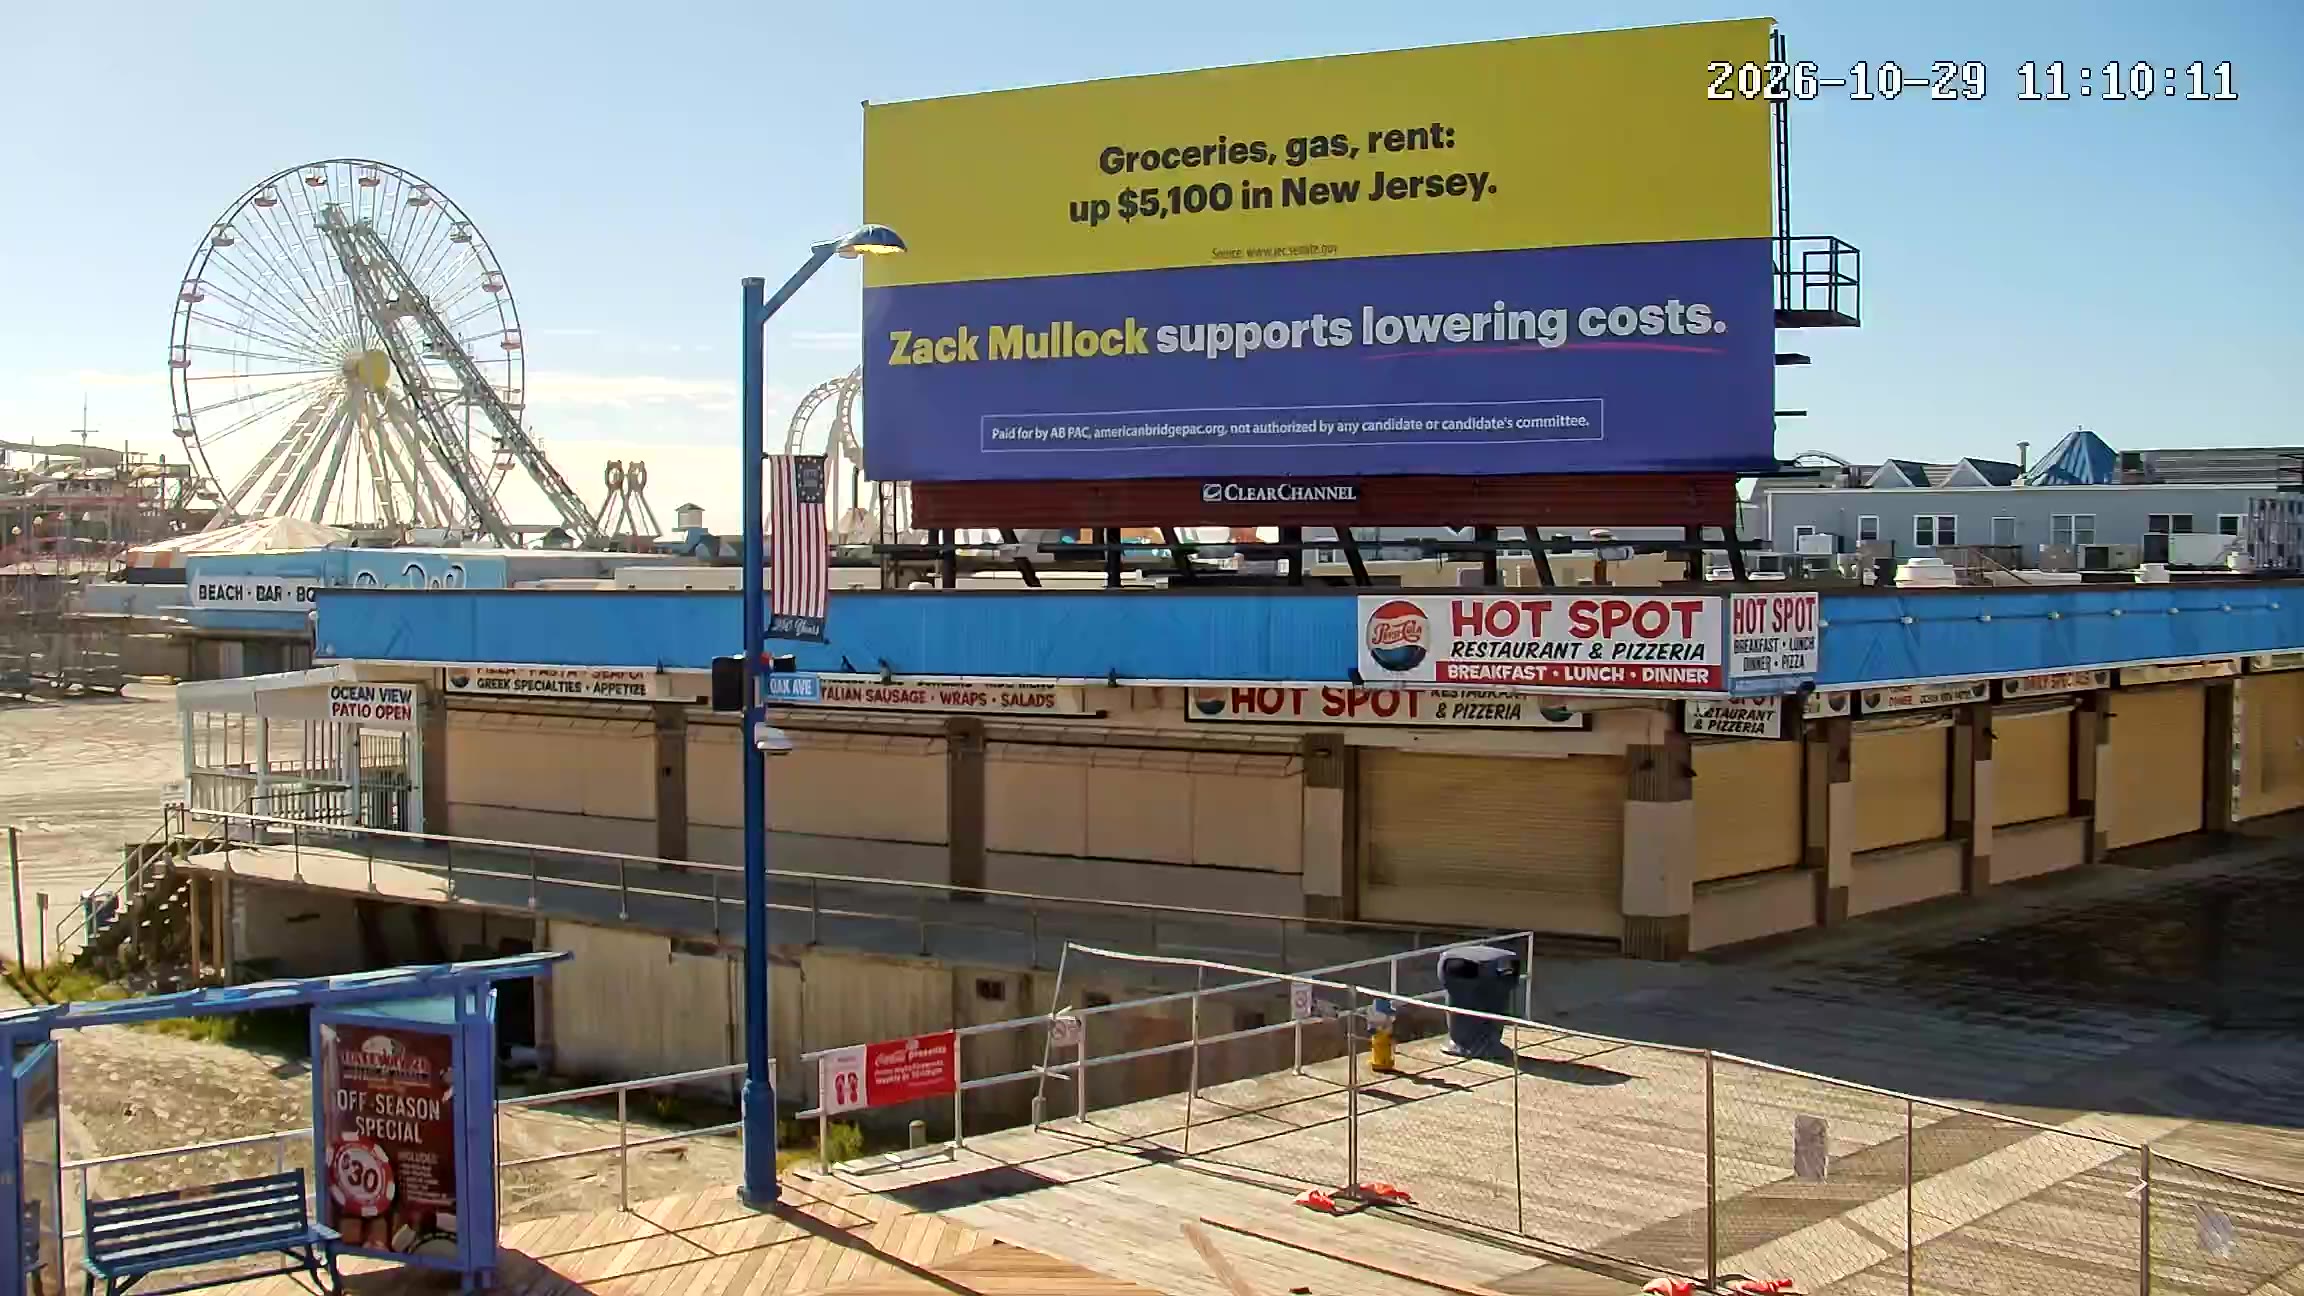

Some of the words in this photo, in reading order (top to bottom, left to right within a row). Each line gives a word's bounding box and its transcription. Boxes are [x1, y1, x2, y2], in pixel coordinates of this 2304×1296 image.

[1099, 135, 1278, 175] Groceries,
[1286, 133, 1360, 166] gas,
[1368, 122, 1456, 153] rent:
[1069, 198, 1110, 227] up
[1117, 182, 1233, 223] $5,100
[1241, 180, 1273, 210] in
[1281, 176, 1361, 208] New
[1368, 170, 1498, 202] Jersey.
[888, 326, 980, 366] Zack
[988, 317, 1149, 361] Mullock
[1156, 313, 1353, 360] supports
[1362, 300, 1568, 348] lowering
[1578, 299, 1728, 337] costs.
[992, 426, 1016, 440] Paid
[1017, 426, 1034, 440] for
[1035, 426, 1048, 441] by
[1231, 423, 1250, 434] not
[1252, 421, 1316, 434] authorized
[1319, 420, 1334, 436] by
[1337, 422, 1359, 436] any
[1362, 417, 1423, 432] candidate
[1426, 420, 1439, 431] or
[1441, 416, 1513, 431] candidate's
[1516, 414, 1590, 429] committee.
[199, 584, 244, 601] BEACH
[256, 585, 282, 601] BAR
[297, 586, 316, 602] BO
[1451, 600, 1552, 638] HOT
[1568, 600, 1704, 639] SPOT
[1733, 598, 1767, 635] HOT
[1772, 596, 1816, 633] SPOT
[1450, 641, 1582, 660] RESTAURANT
[1588, 642, 1603, 660] &
[1612, 642, 1705, 661] PIZZERIA
[1447, 664, 1547, 681] BREAKFAST
[1564, 666, 1625, 682] LUNCH
[1642, 667, 1709, 684] DINNER
[331, 686, 375, 701] OCEAN
[379, 687, 412, 703] VIEW
[477, 677, 511, 690] GREEK
[513, 679, 582, 694] SPECIALTIES
[593, 681, 647, 696] APPETIZE
[769, 678, 791, 695] OAK
[792, 678, 812, 695] AVE
[821, 686, 863, 701] TALIAN
[865, 687, 927, 705] SAUSAGE
[940, 691, 988, 706] WRAPS
[1001, 692, 1056, 707] SALADS
[332, 702, 372, 718] PATIO
[375, 704, 412, 720] OPEN
[1231, 687, 1309, 716] HOT
[1321, 686, 1425, 718] SPOT
[1435, 702, 1447, 719] &
[1452, 703, 1521, 720] PIZZERIA
[1707, 719, 1765, 734] PIZZERIA
[355, 1116, 423, 1144] SPECIAL
